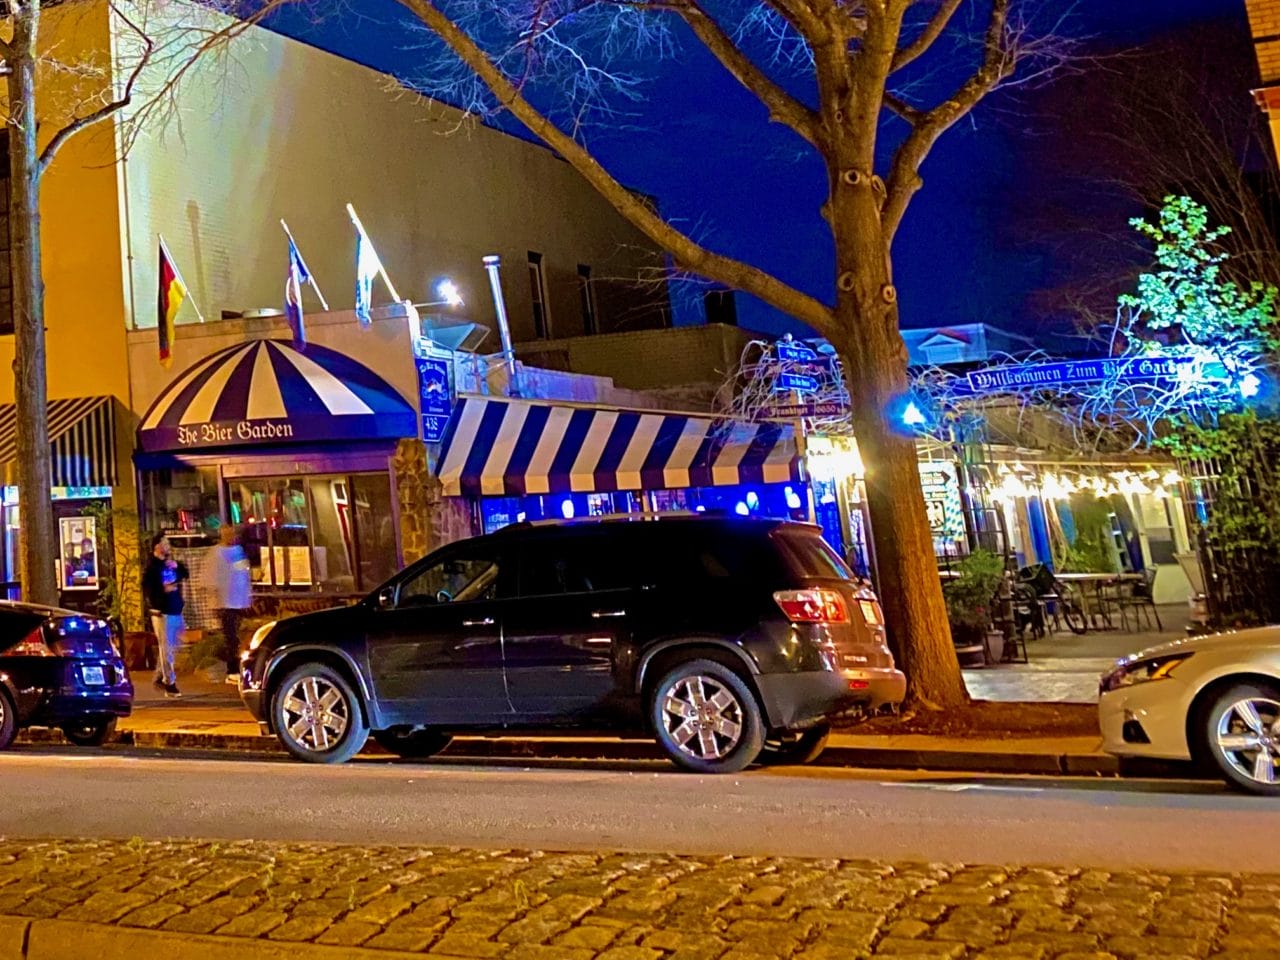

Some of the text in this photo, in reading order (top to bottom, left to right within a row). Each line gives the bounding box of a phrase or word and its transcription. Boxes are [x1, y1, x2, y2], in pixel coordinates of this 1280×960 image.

[974, 367, 1061, 388] Willkommen
[1066, 363, 1098, 378] Zum
[1138, 359, 1197, 376] Gard
[177, 420, 294, 447] The Bier Garden
